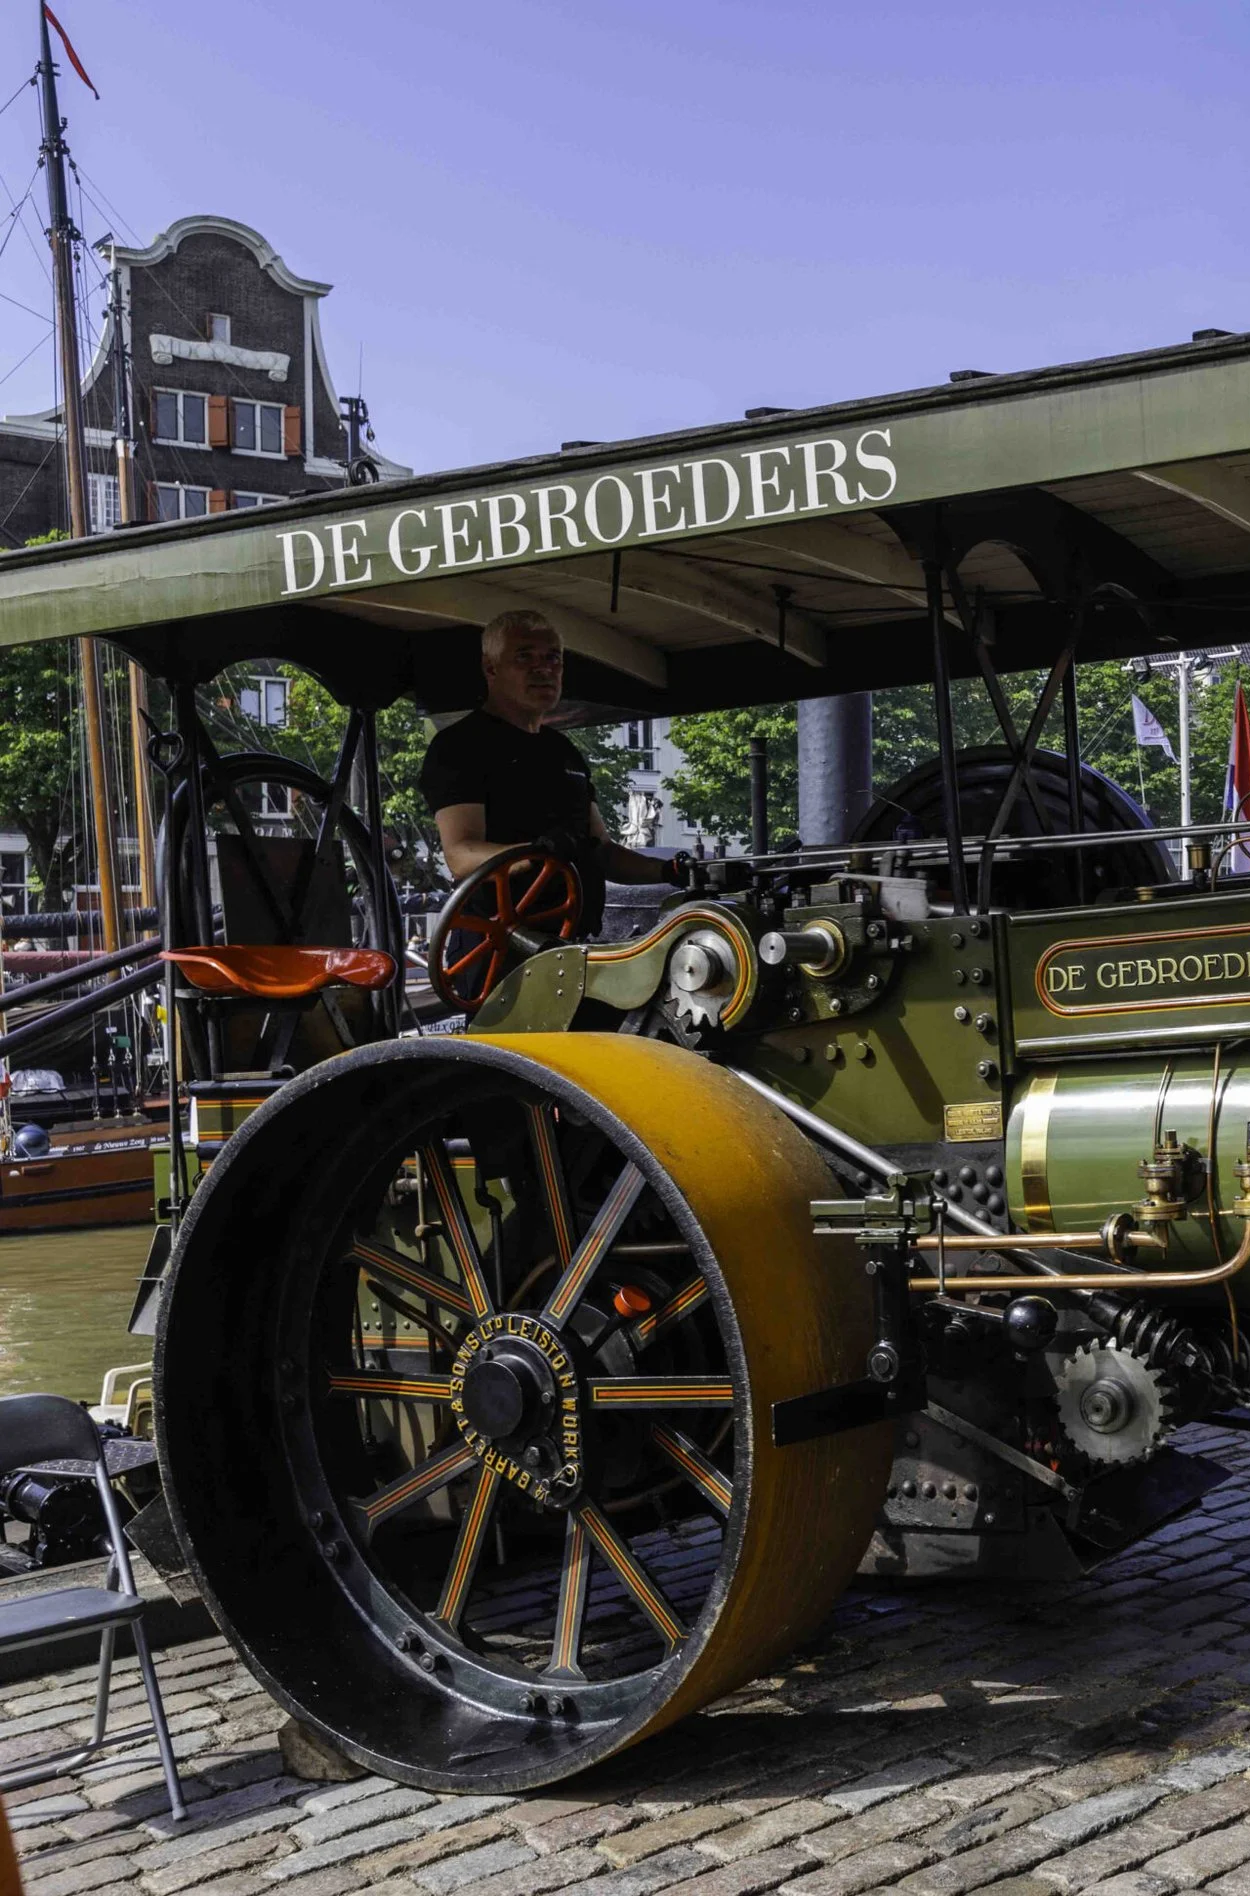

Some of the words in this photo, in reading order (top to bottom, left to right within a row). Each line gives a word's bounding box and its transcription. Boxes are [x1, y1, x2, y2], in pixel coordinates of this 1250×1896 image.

[275, 519, 373, 595] DE
[386, 428, 900, 576] GEBROEDERS
[1047, 965, 1087, 993] DE
[450, 1332, 481, 1392] SONS
[507, 1316, 575, 1388] LEISTON
[450, 1397, 464, 1413] &
[456, 1417, 531, 1490] GARRETT
